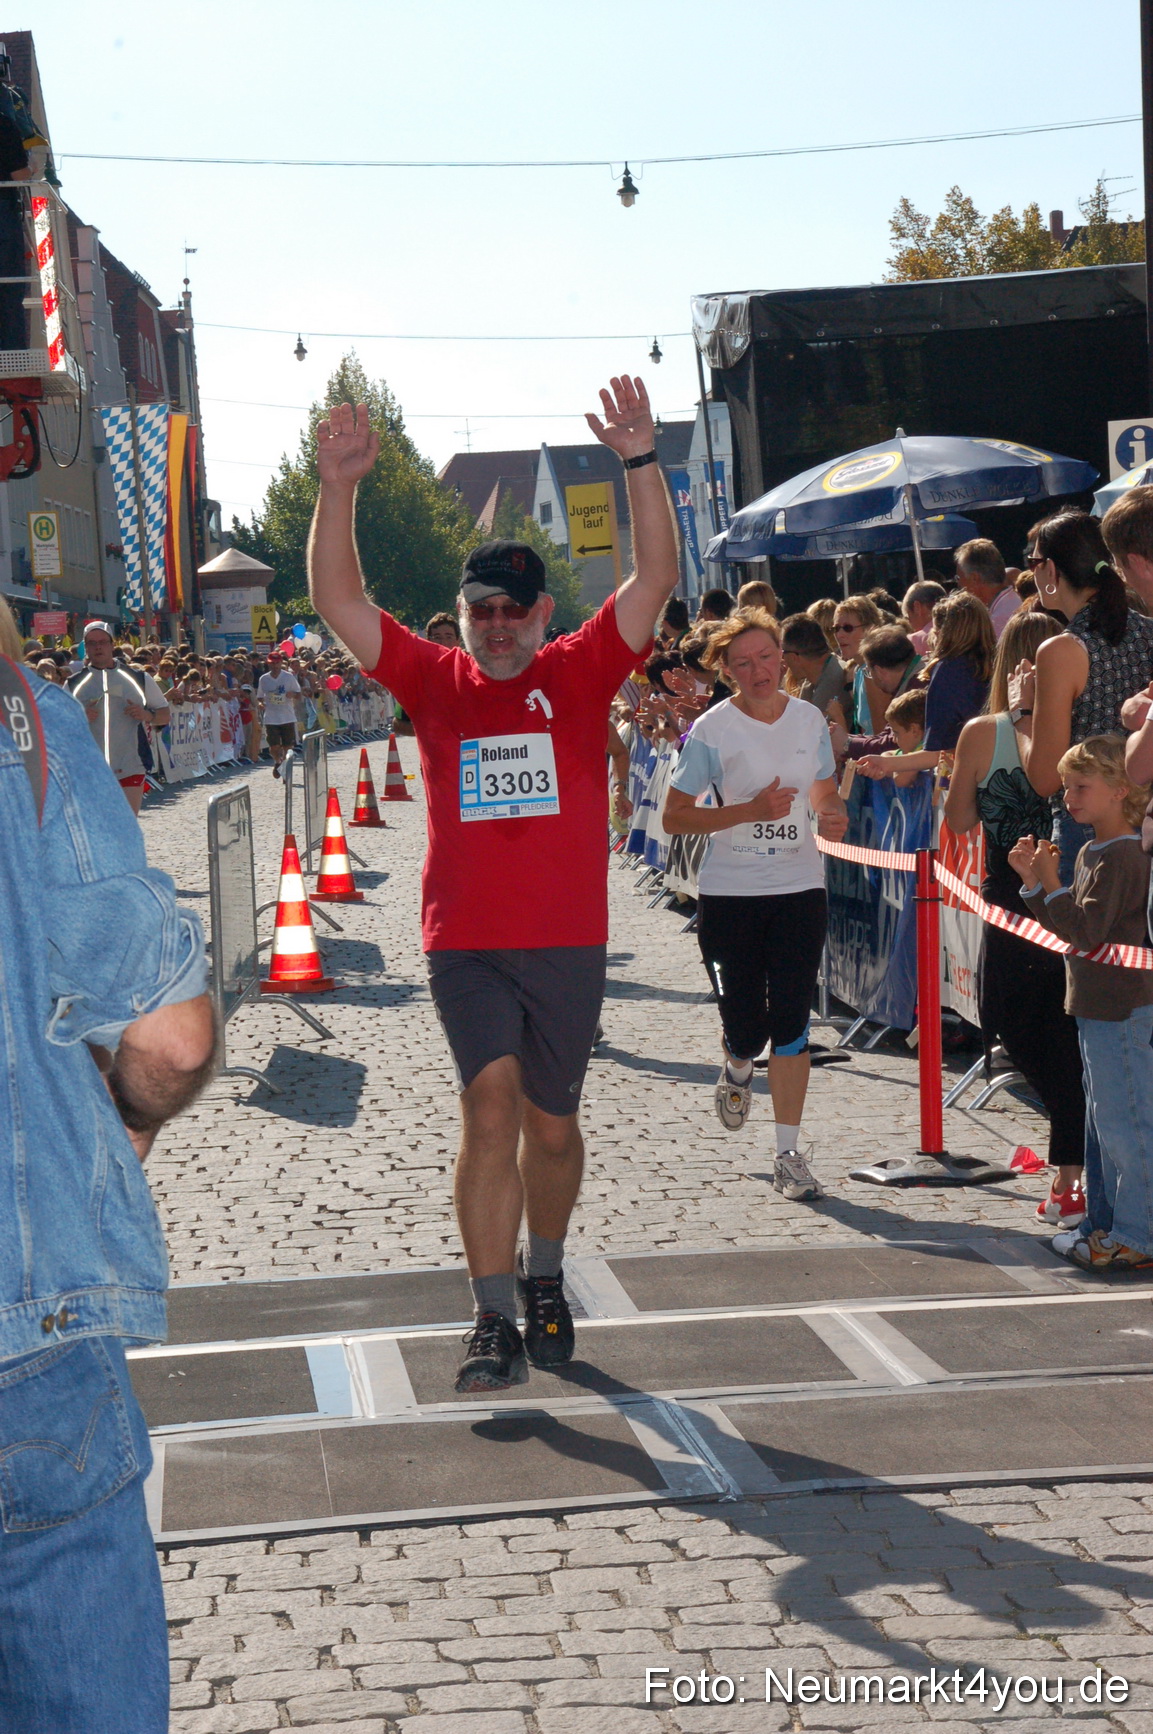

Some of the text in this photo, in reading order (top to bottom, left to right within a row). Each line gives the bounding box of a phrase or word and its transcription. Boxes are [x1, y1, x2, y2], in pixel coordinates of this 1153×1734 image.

[569, 503, 610, 518] Jugend
[717, 500, 729, 531] UPPERT
[583, 515, 604, 529] lauf
[254, 606, 273, 614] Block
[257, 616, 271, 633] A
[3, 695, 34, 752] EOS
[481, 744, 529, 763] Roland
[465, 771, 475, 784] D
[484, 769, 551, 798] 3303
[520, 801, 558, 812] PFLEIDERER
[753, 823, 798, 841] 3548
[827, 913, 872, 966] RUPPE
